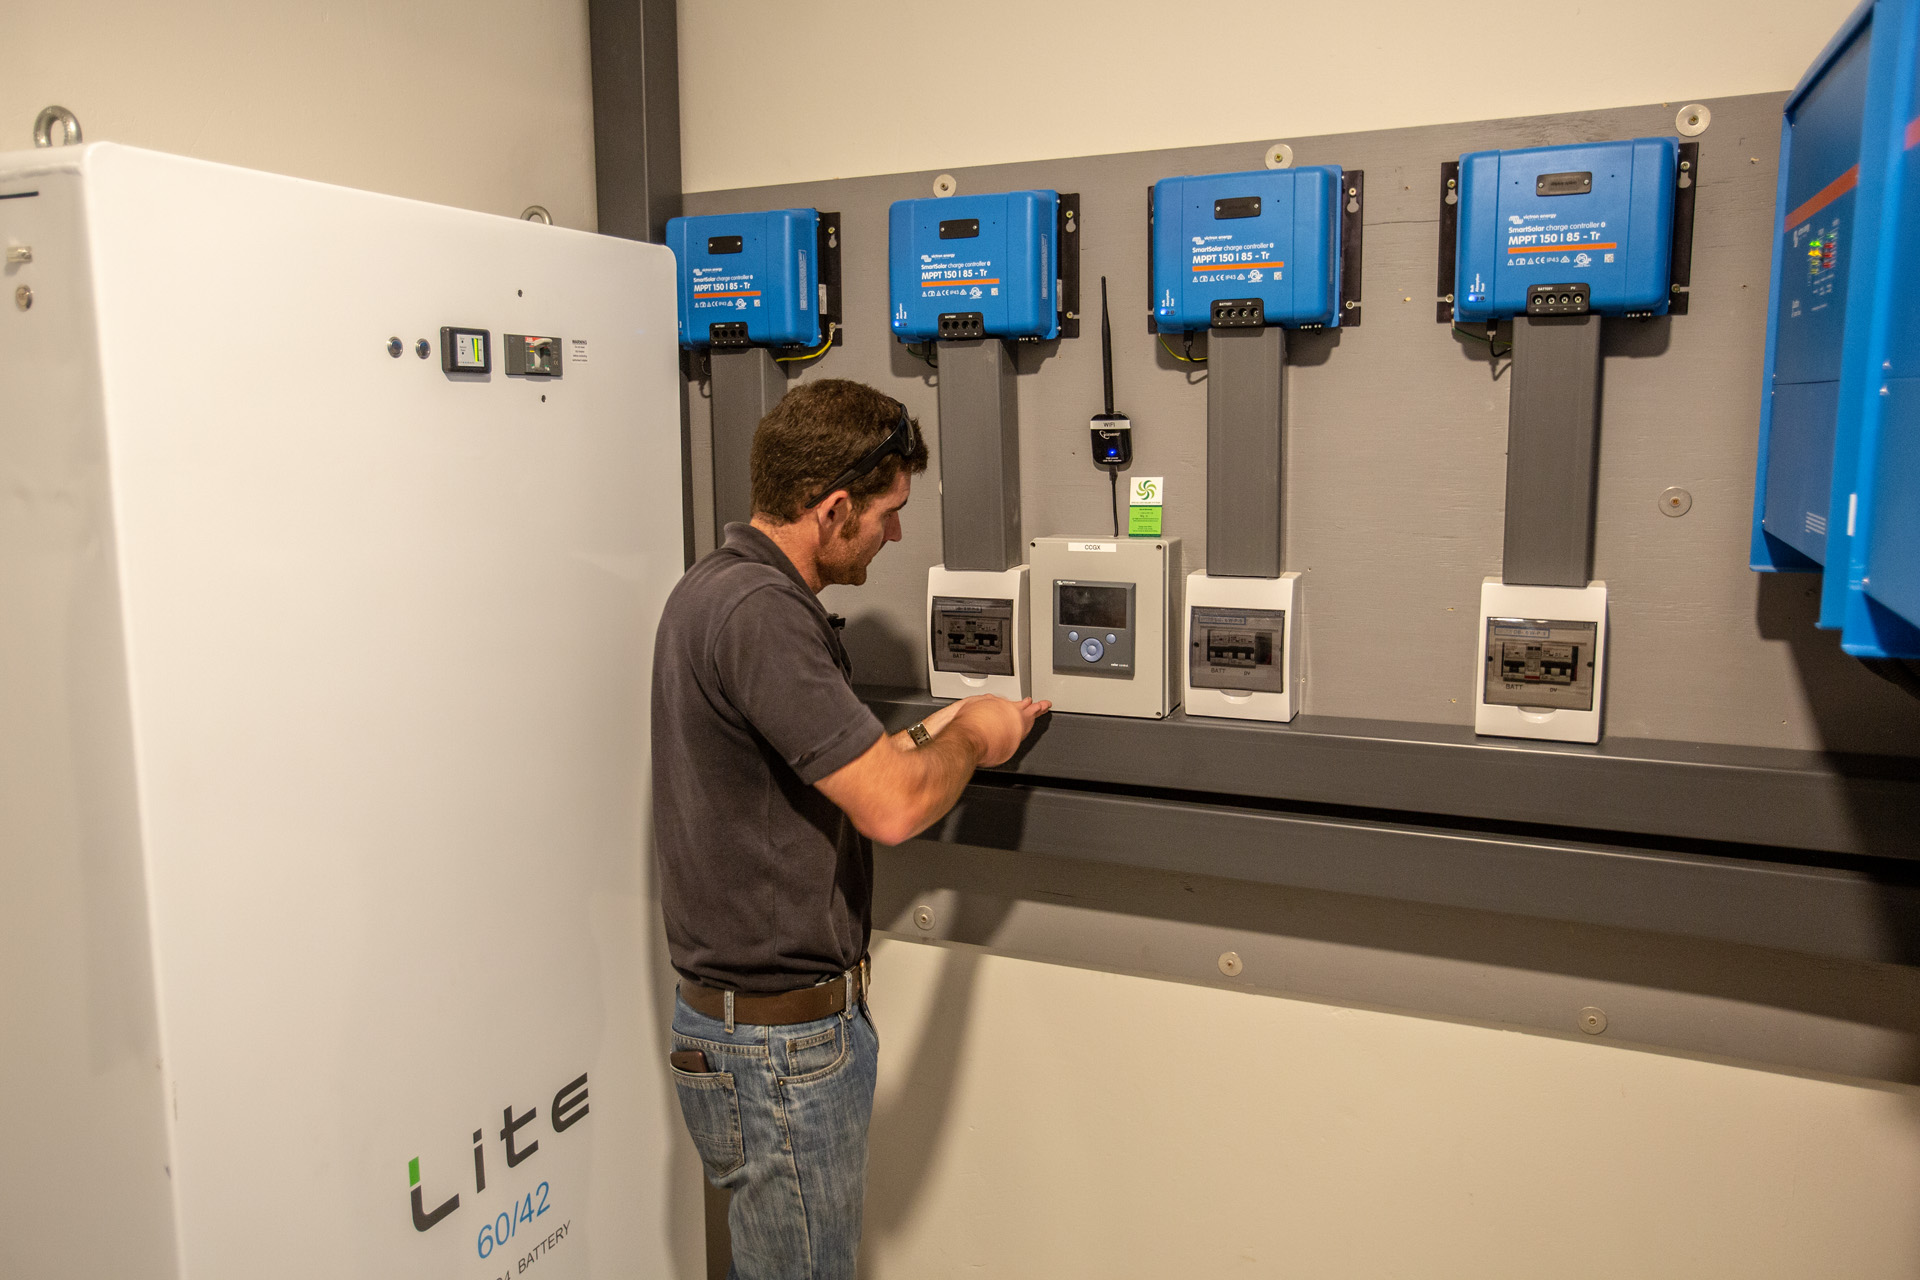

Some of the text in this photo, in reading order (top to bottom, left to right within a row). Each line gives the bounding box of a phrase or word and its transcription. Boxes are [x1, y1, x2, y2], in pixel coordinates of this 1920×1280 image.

[1508, 222, 1600, 234] SmartSolar charge controller
[1508, 235, 1537, 246] MPPT
[1540, 233, 1558, 244] 150
[1566, 232, 1580, 242] 85
[1590, 231, 1600, 241] Tr
[1192, 246, 1223, 254] SmartSolar
[1223, 244, 1243, 252] charge
[1192, 254, 1217, 264] MPPT
[1219, 253, 1234, 263] 150
[1241, 252, 1253, 261] 85
[1261, 251, 1270, 260] Tr
[922, 271, 942, 280] MPPT
[944, 270, 957, 278] 150
[963, 269, 973, 278] 85
[979, 268, 987, 277] Tr
[693, 283, 712, 292] MPPT
[712, 283, 725, 291] 150
[729, 282, 738, 290] 85
[743, 281, 751, 289] Tr
[408, 1072, 590, 1232] Lite
[477, 1181, 551, 1259] 60/42
[518, 1219, 571, 1275] BATTERY
